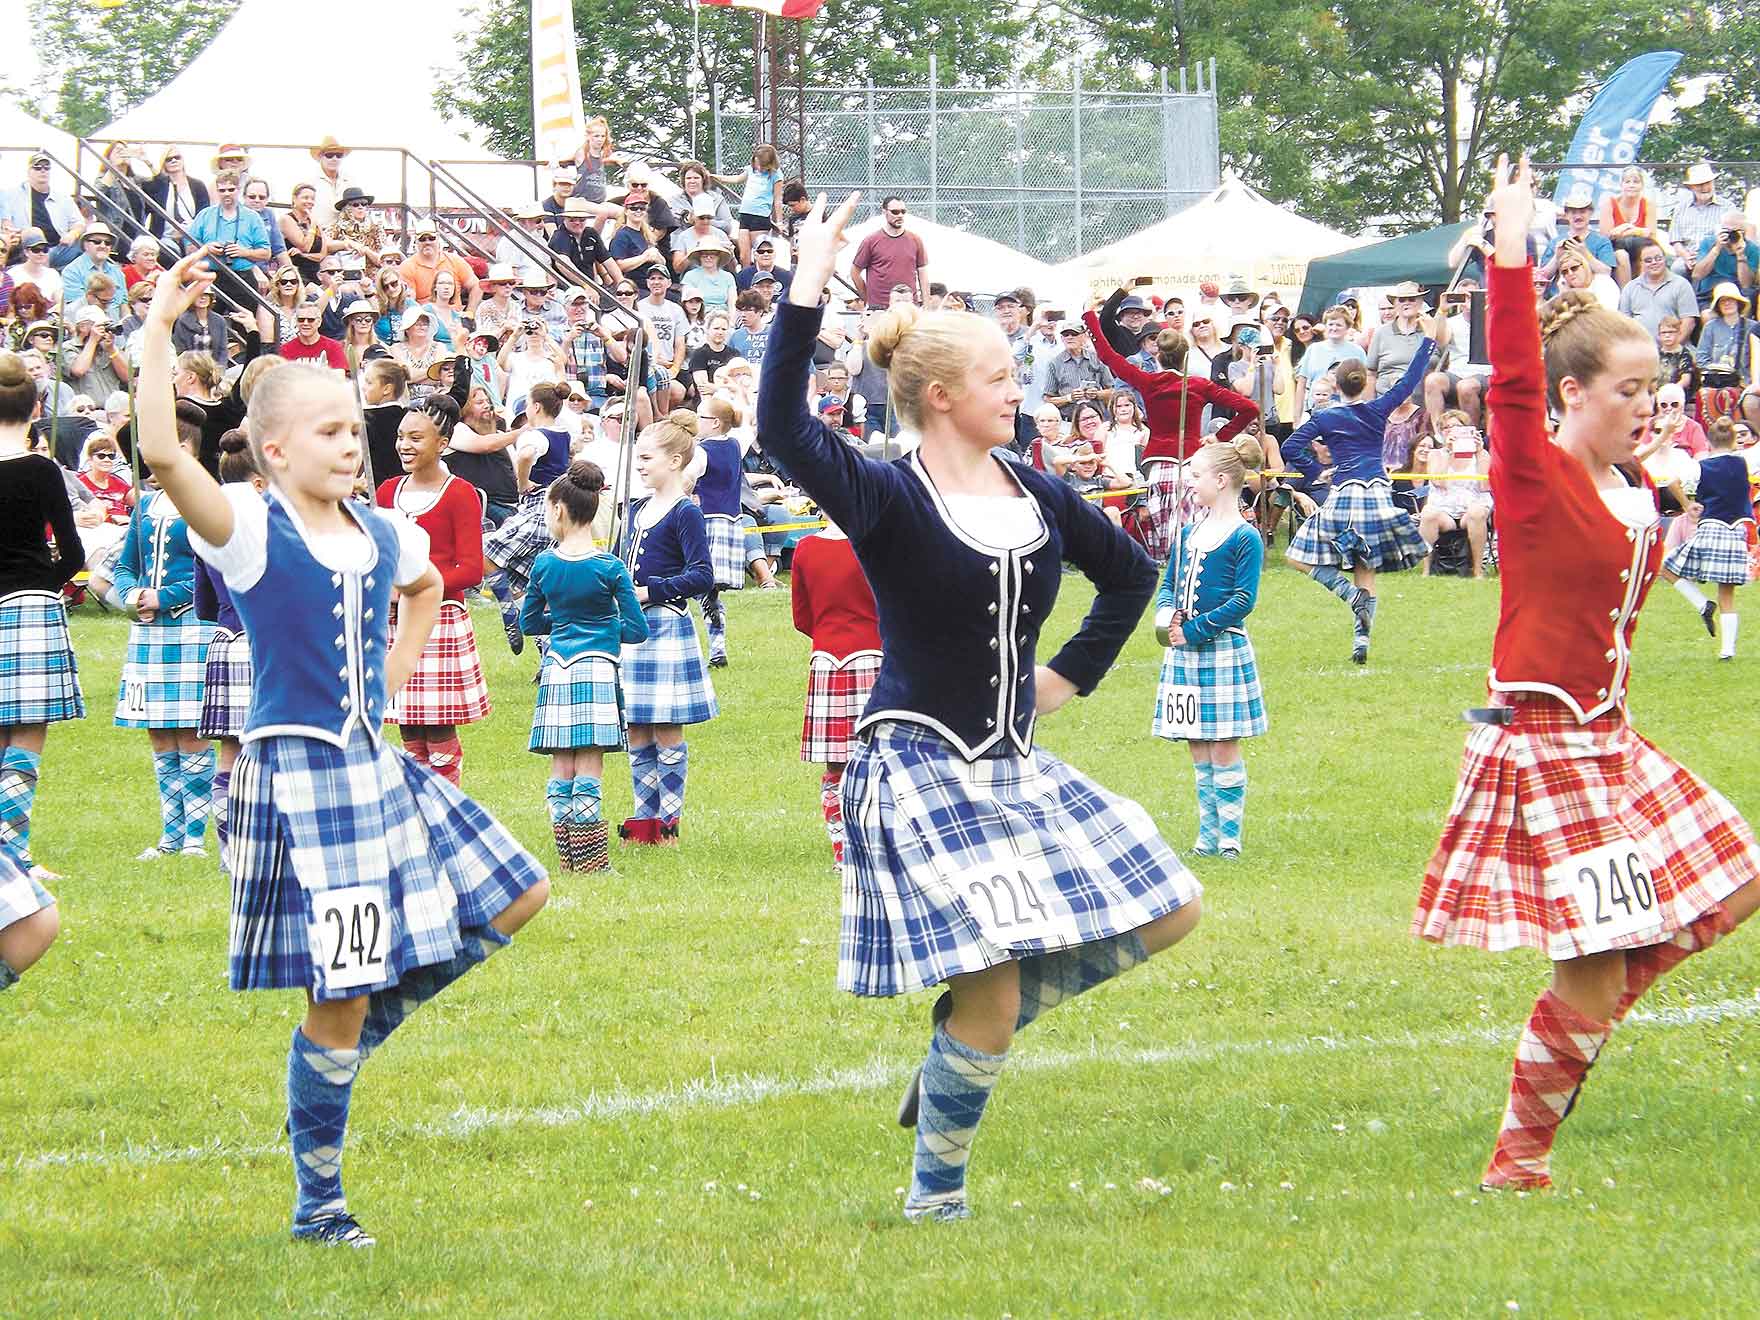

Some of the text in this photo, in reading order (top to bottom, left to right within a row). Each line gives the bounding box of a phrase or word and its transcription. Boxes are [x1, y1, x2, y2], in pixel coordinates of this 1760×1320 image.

[1167, 692, 1196, 725] 650
[969, 870, 1048, 928] 224
[1578, 852, 1652, 924] 246
[325, 902, 382, 970] 242
